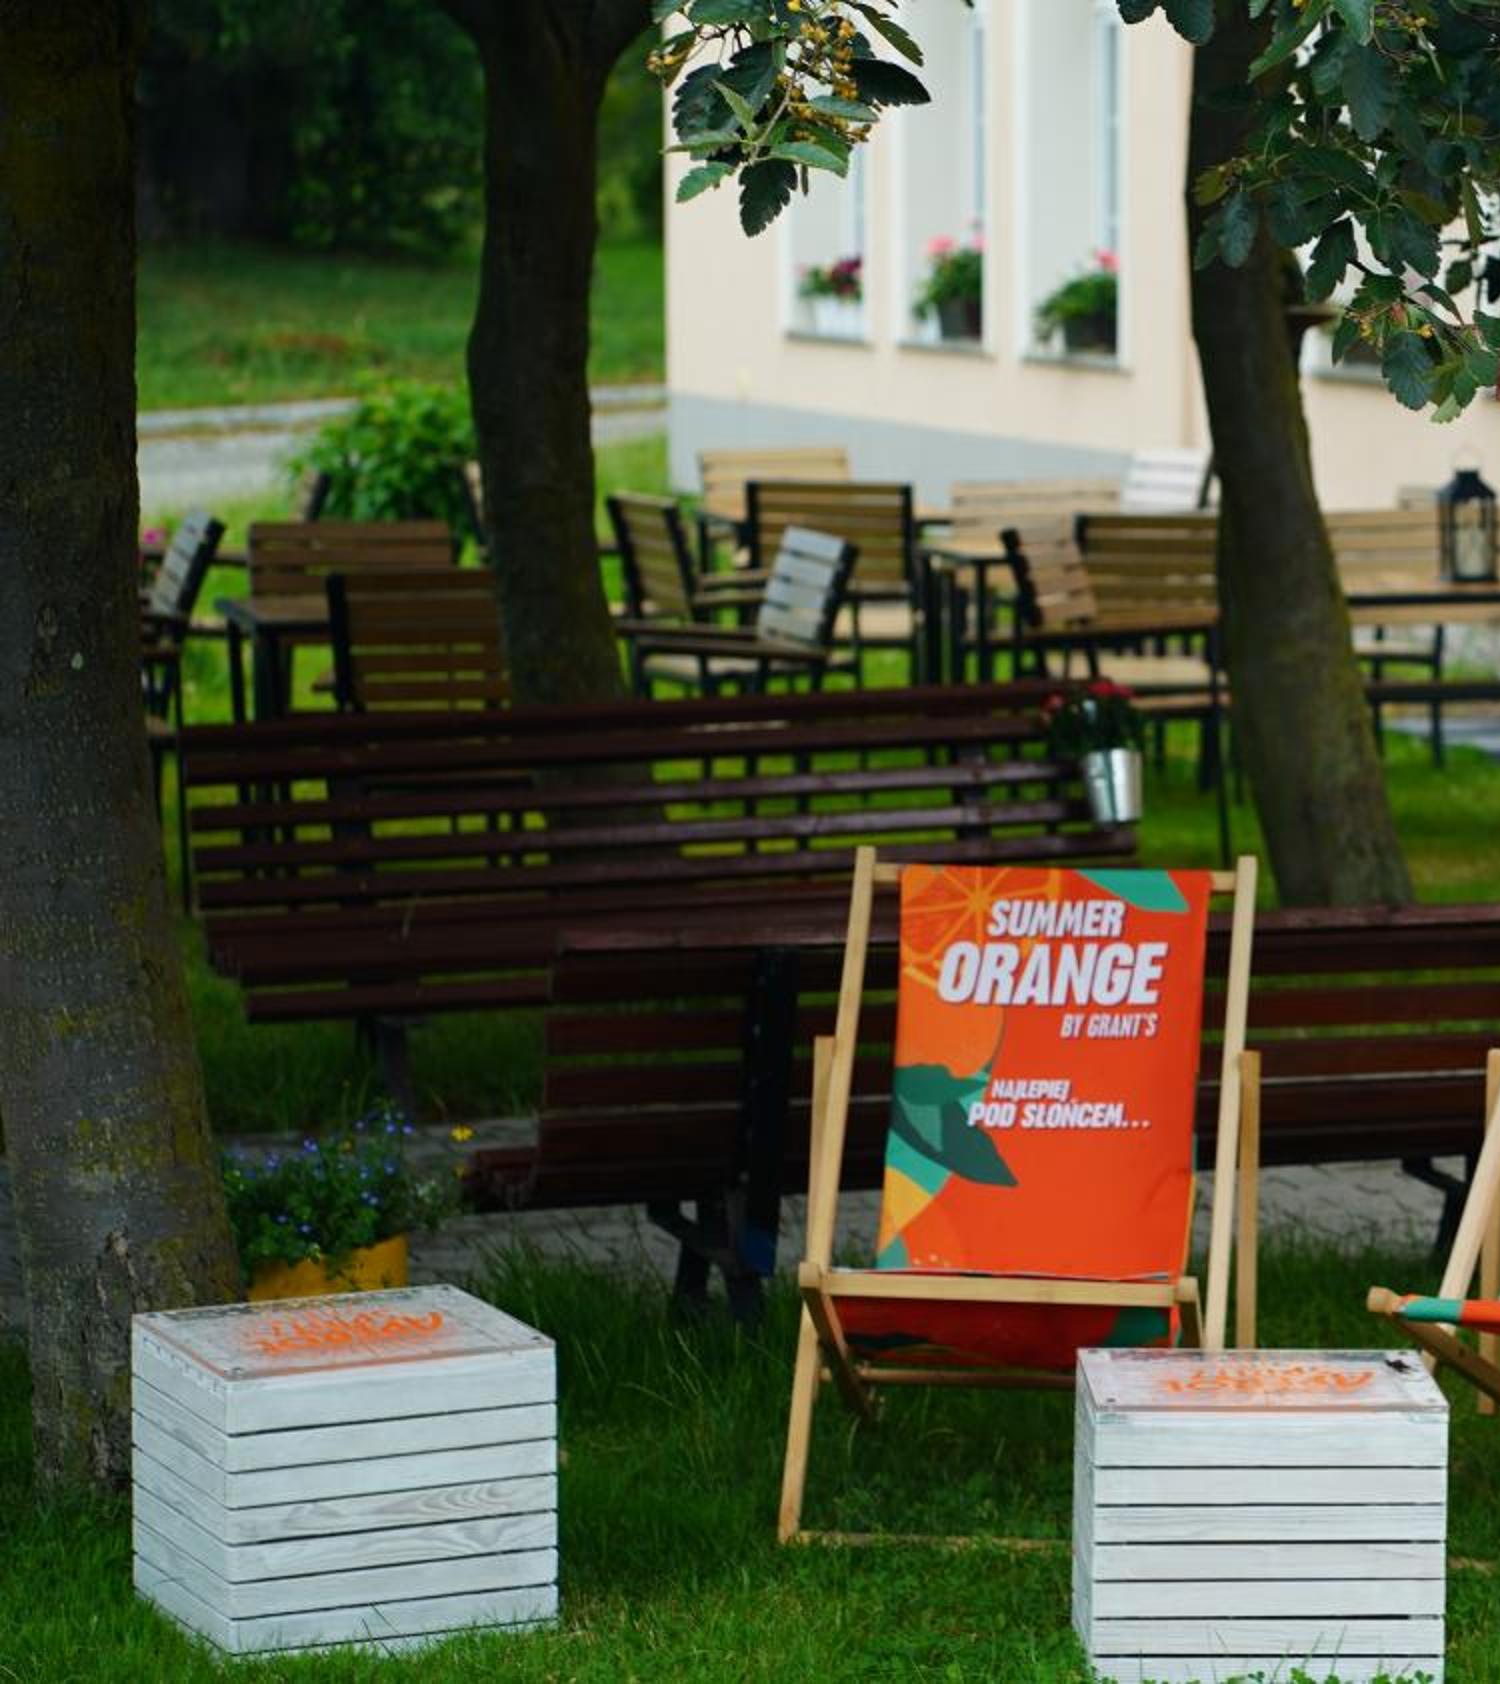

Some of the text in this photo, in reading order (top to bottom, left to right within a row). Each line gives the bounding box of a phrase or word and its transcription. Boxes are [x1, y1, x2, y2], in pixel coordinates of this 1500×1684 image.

[988, 900, 1125, 937] SUMMER
[937, 941, 1168, 1006] ORANGE
[1060, 1013, 1158, 1038] BY GRANT'S
[991, 1079, 1071, 1102] NAJLEPIEJ
[967, 1101, 1017, 1128] POD
